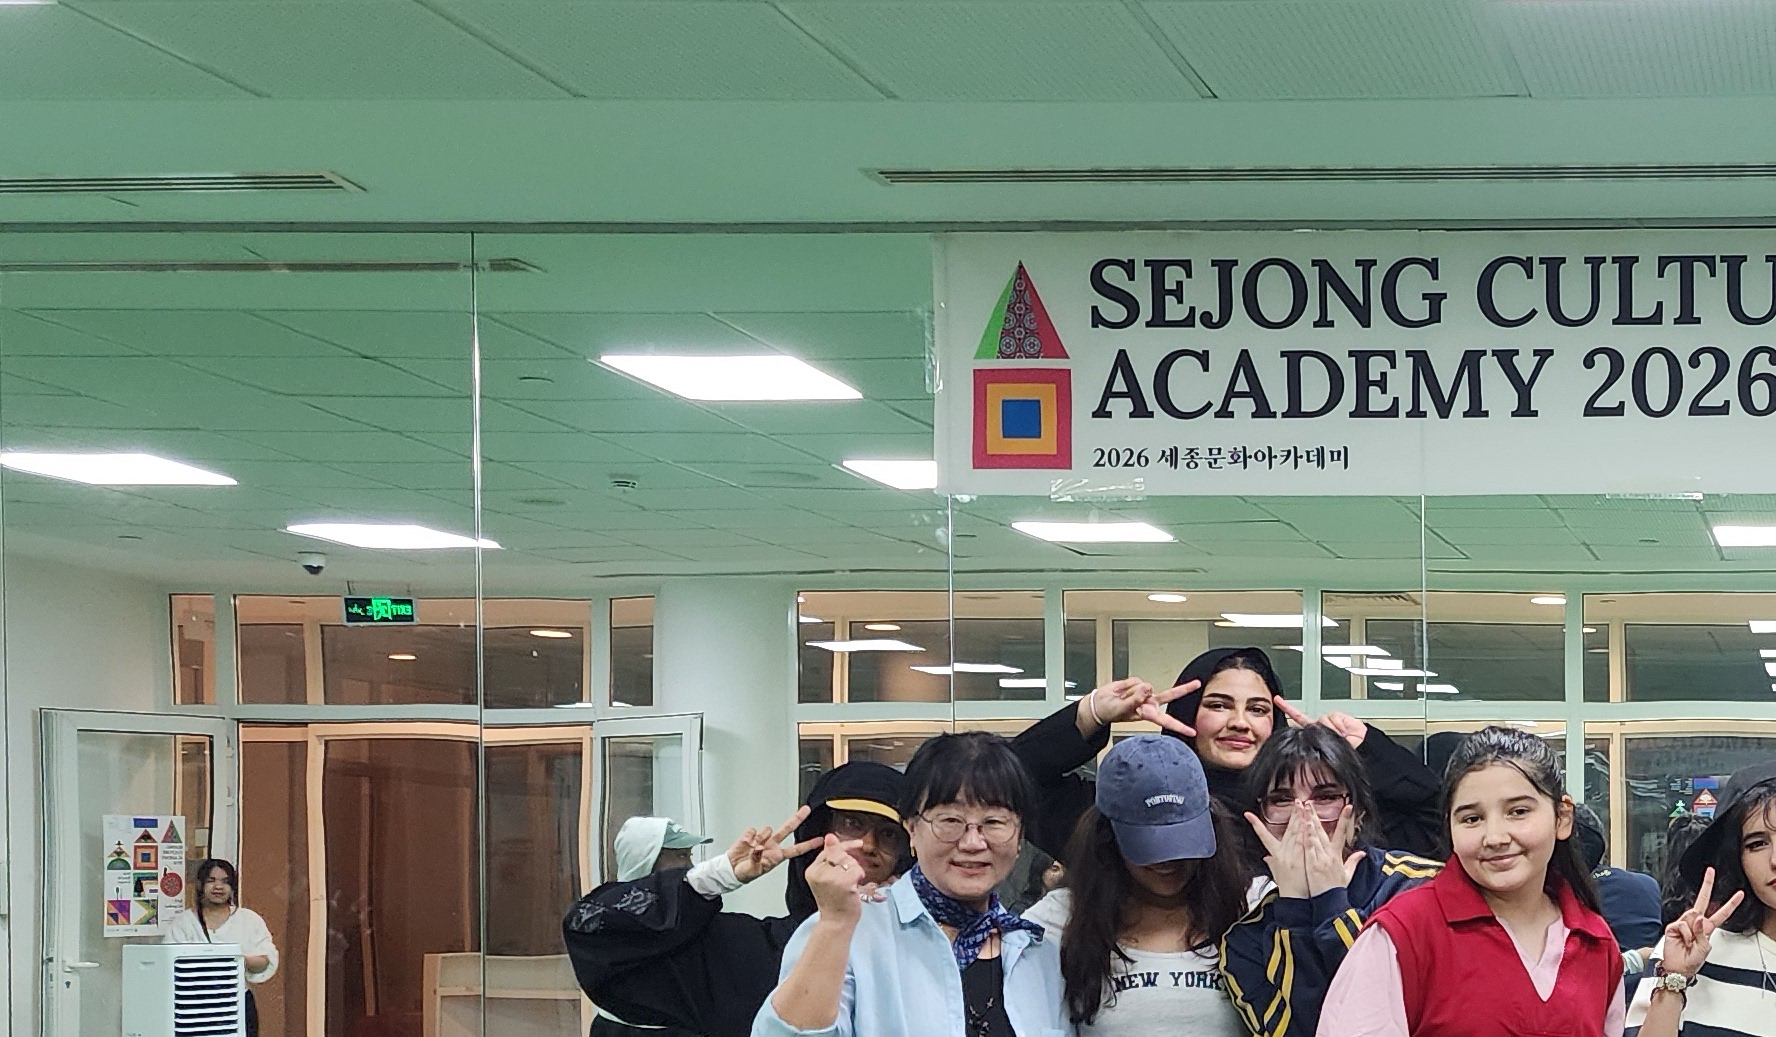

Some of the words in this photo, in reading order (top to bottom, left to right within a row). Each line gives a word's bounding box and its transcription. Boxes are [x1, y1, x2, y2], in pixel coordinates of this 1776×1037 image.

[1089, 256, 1448, 331] SEJONG
[1092, 348, 1554, 421] ACADEMY
[1092, 447, 1150, 468] 2026
[1156, 445, 1350, 470] 세종문화아카데미
[1114, 972, 1159, 993] NEW
[1169, 971, 1224, 990] YORK
